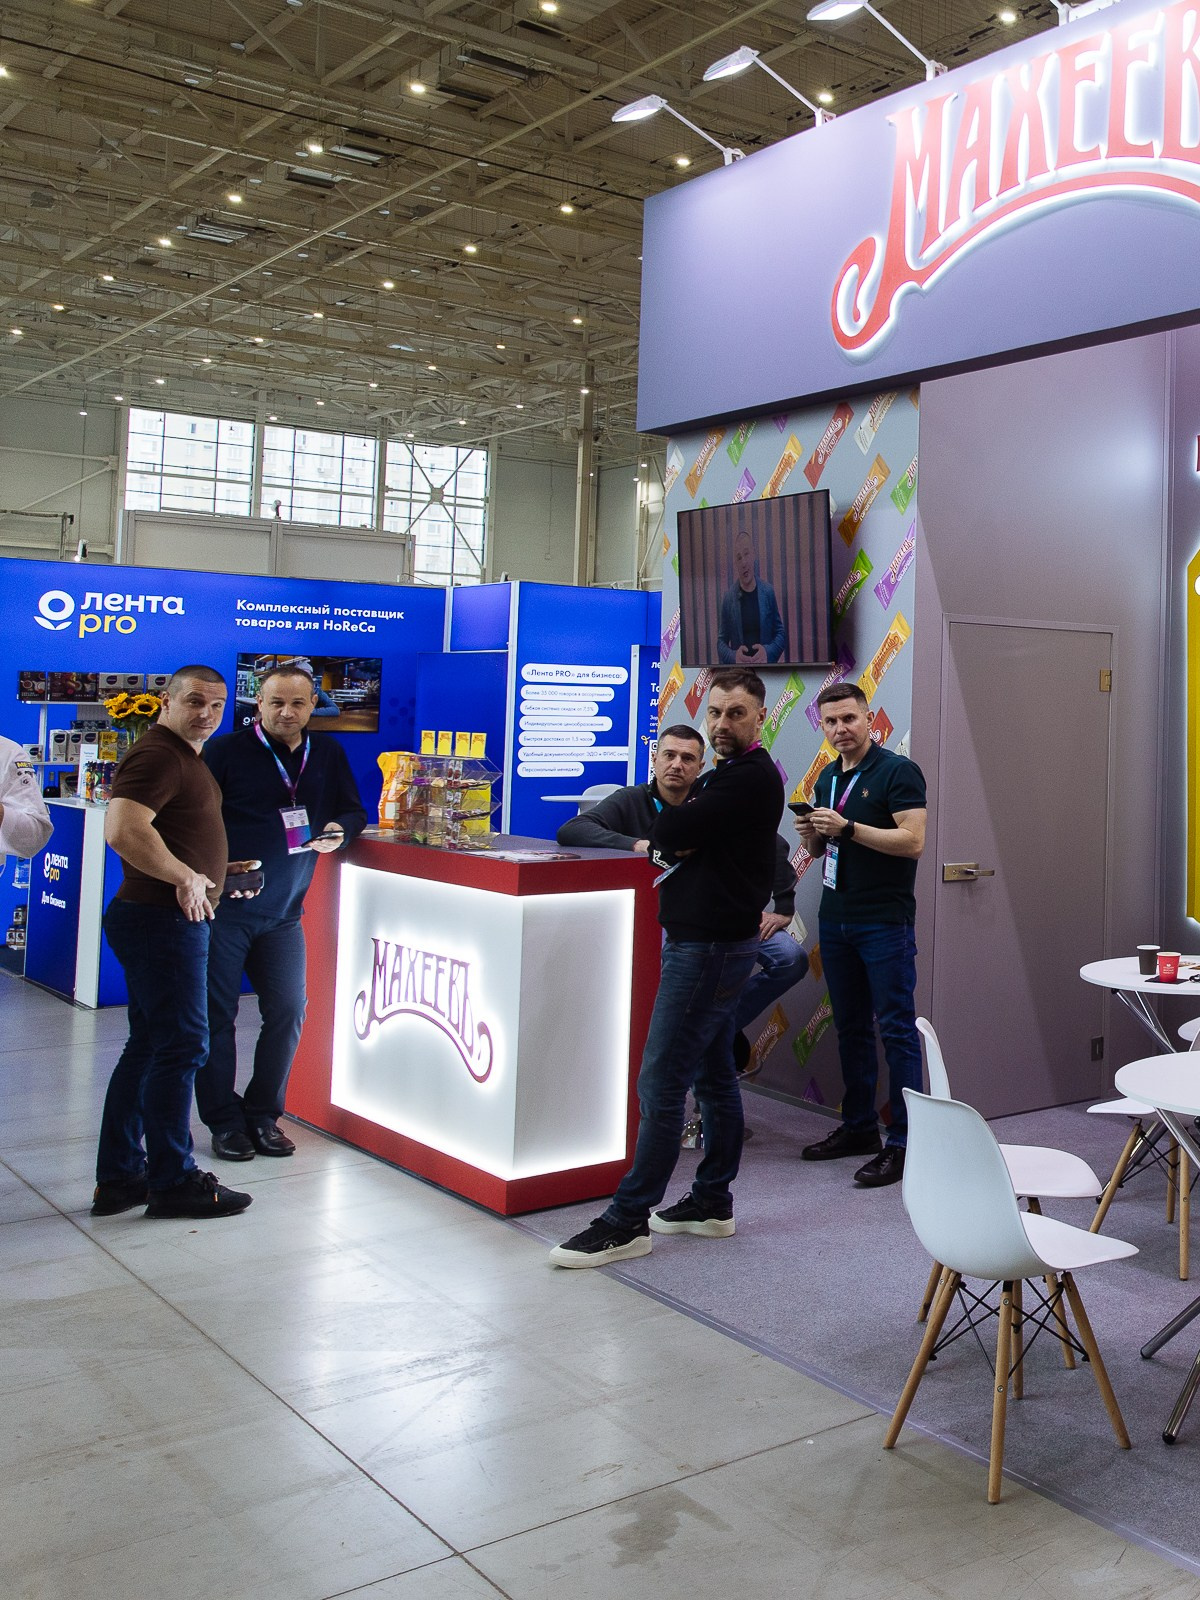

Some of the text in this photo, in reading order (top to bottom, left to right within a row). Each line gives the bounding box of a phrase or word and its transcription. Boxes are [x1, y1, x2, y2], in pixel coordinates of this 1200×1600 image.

[80, 591, 186, 615] лента
[236, 599, 405, 620] Комплексный поставщик
[78, 612, 137, 639] pro
[235, 617, 376, 633] товаров для HoReCa
